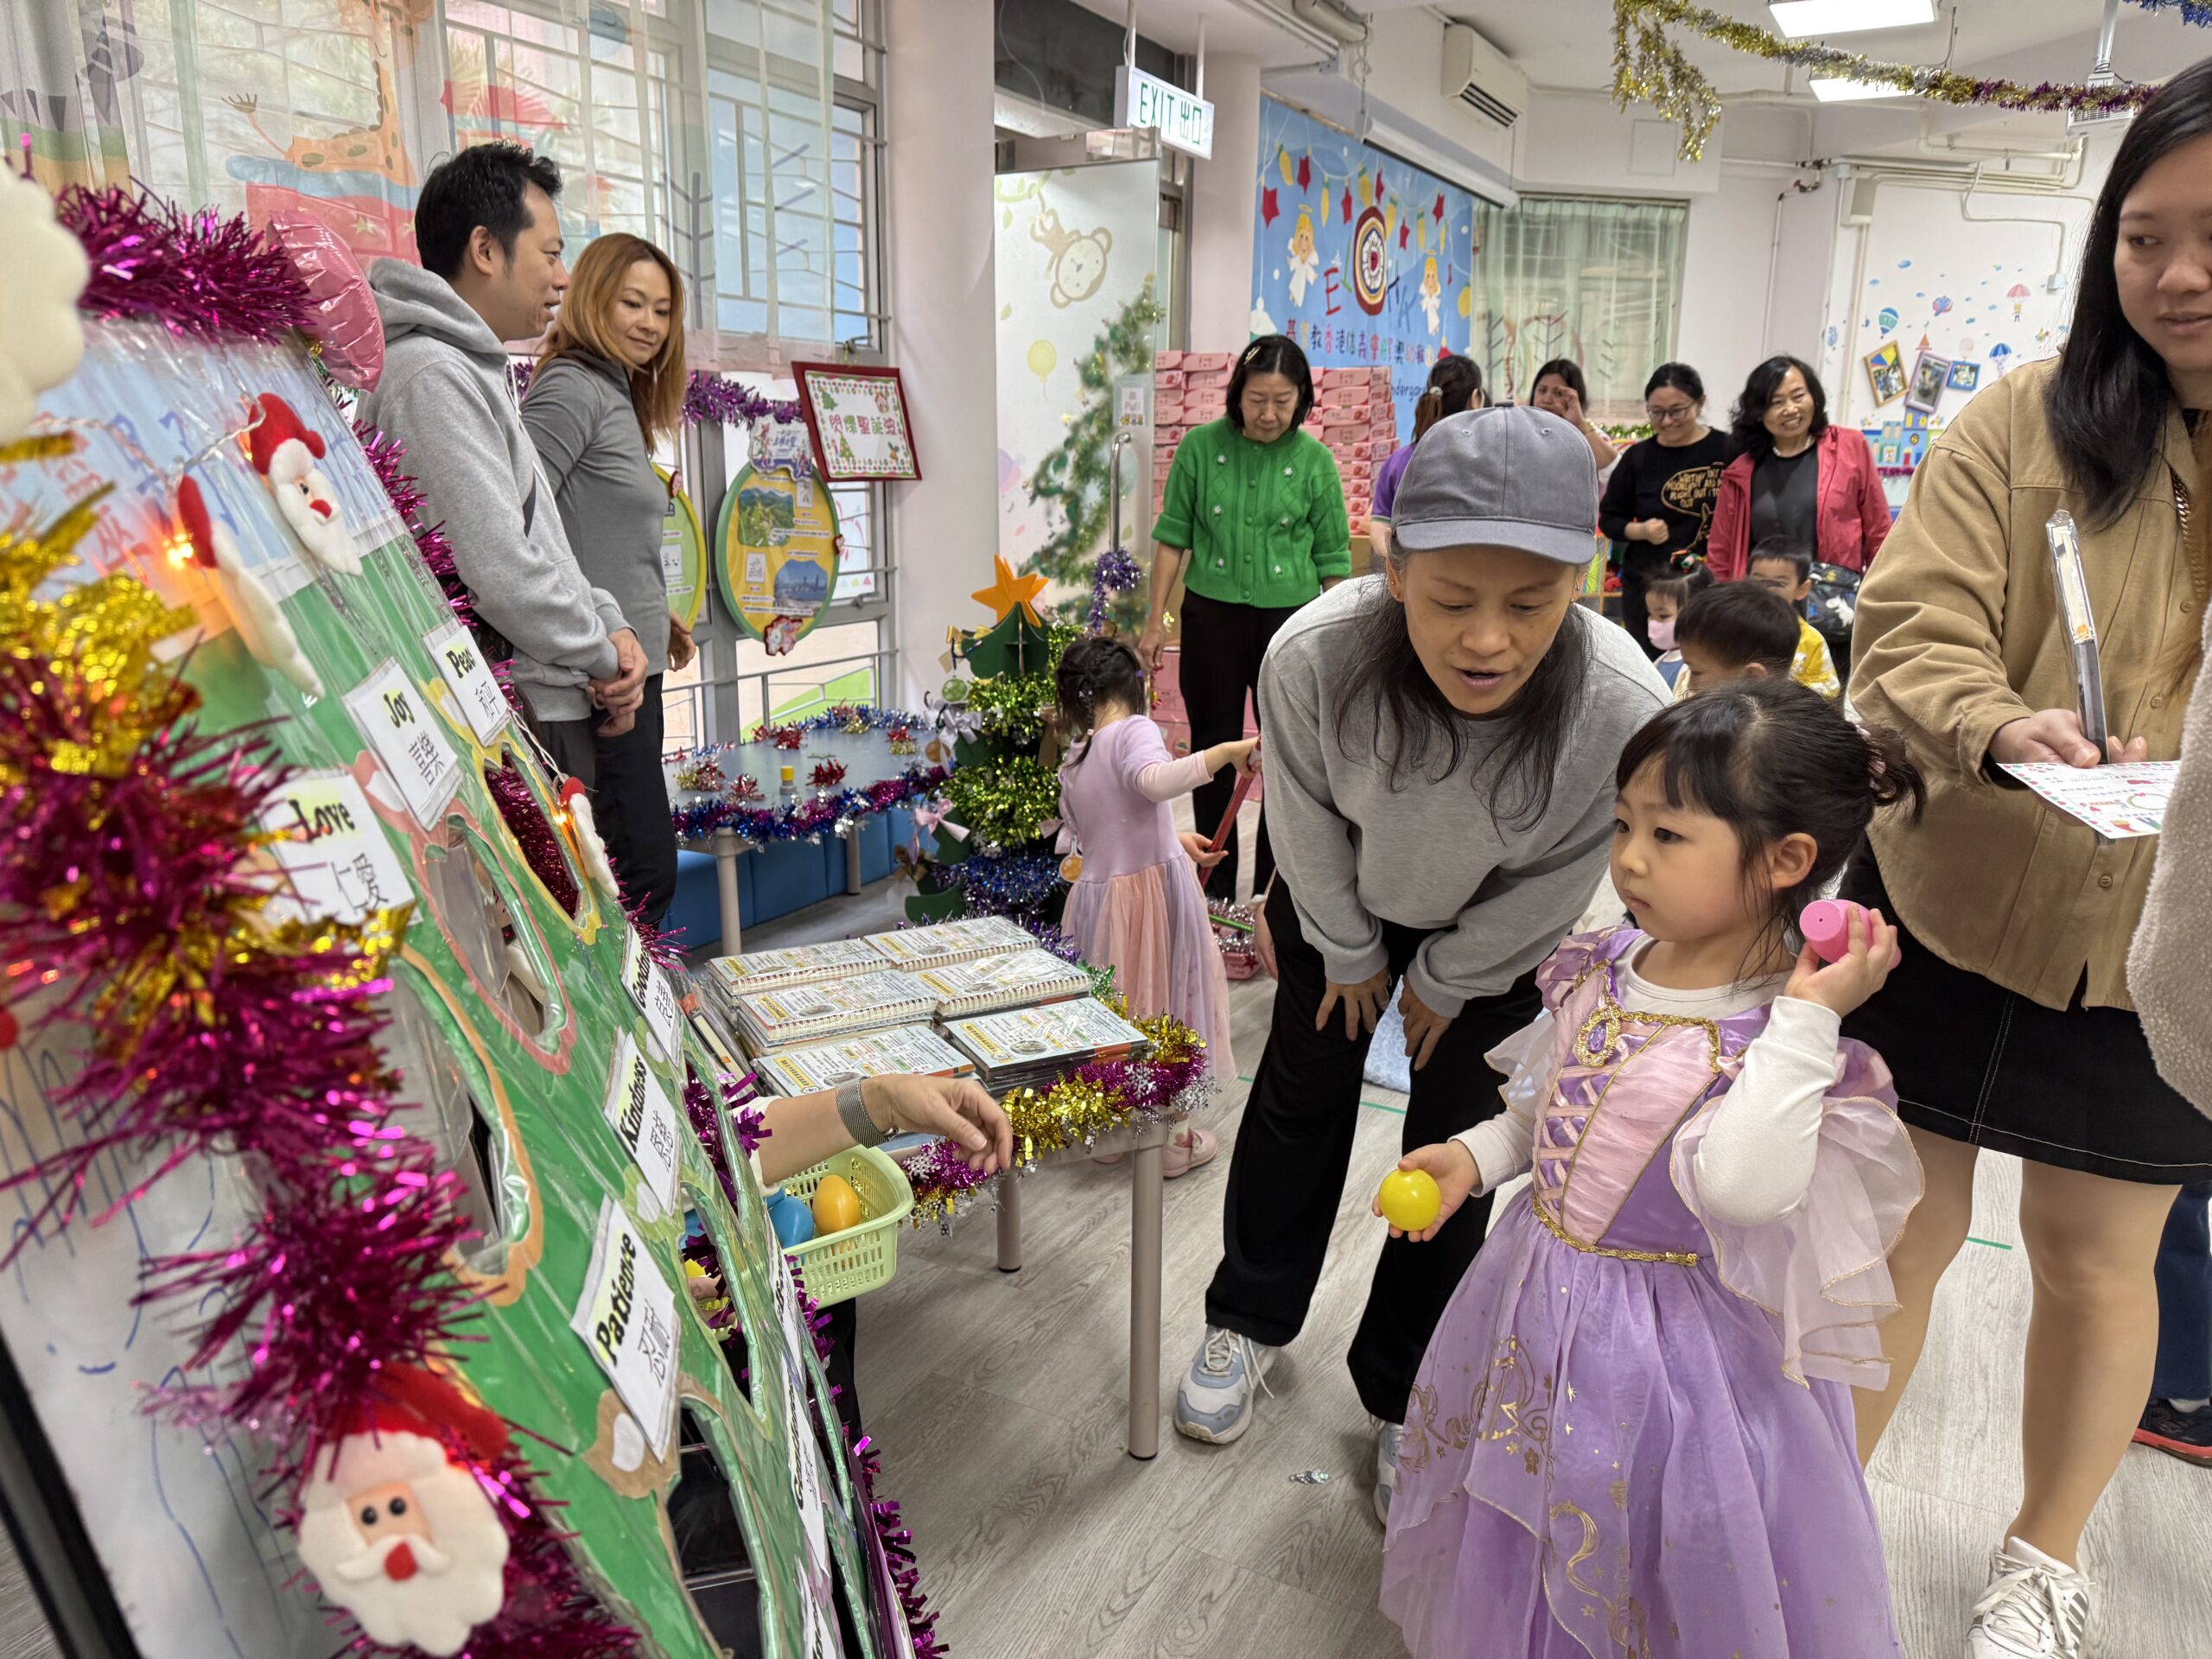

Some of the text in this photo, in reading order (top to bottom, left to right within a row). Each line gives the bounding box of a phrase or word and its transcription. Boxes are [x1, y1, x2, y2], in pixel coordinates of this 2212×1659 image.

[1140, 81, 1175, 136] EXIT
[1179, 99, 1203, 145] 出口
[383, 690, 416, 728] Joy
[474, 680, 501, 722] 和平
[408, 730, 445, 787] 喜樂
[288, 798, 356, 843] Love
[330, 852, 390, 917] 仁愛
[654, 979, 674, 1029] 良善
[620, 1054, 647, 1154] Kindness
[650, 1109, 674, 1173] 恩慈
[596, 1232, 637, 1368] Patience
[637, 1298, 671, 1388] 忍耐
